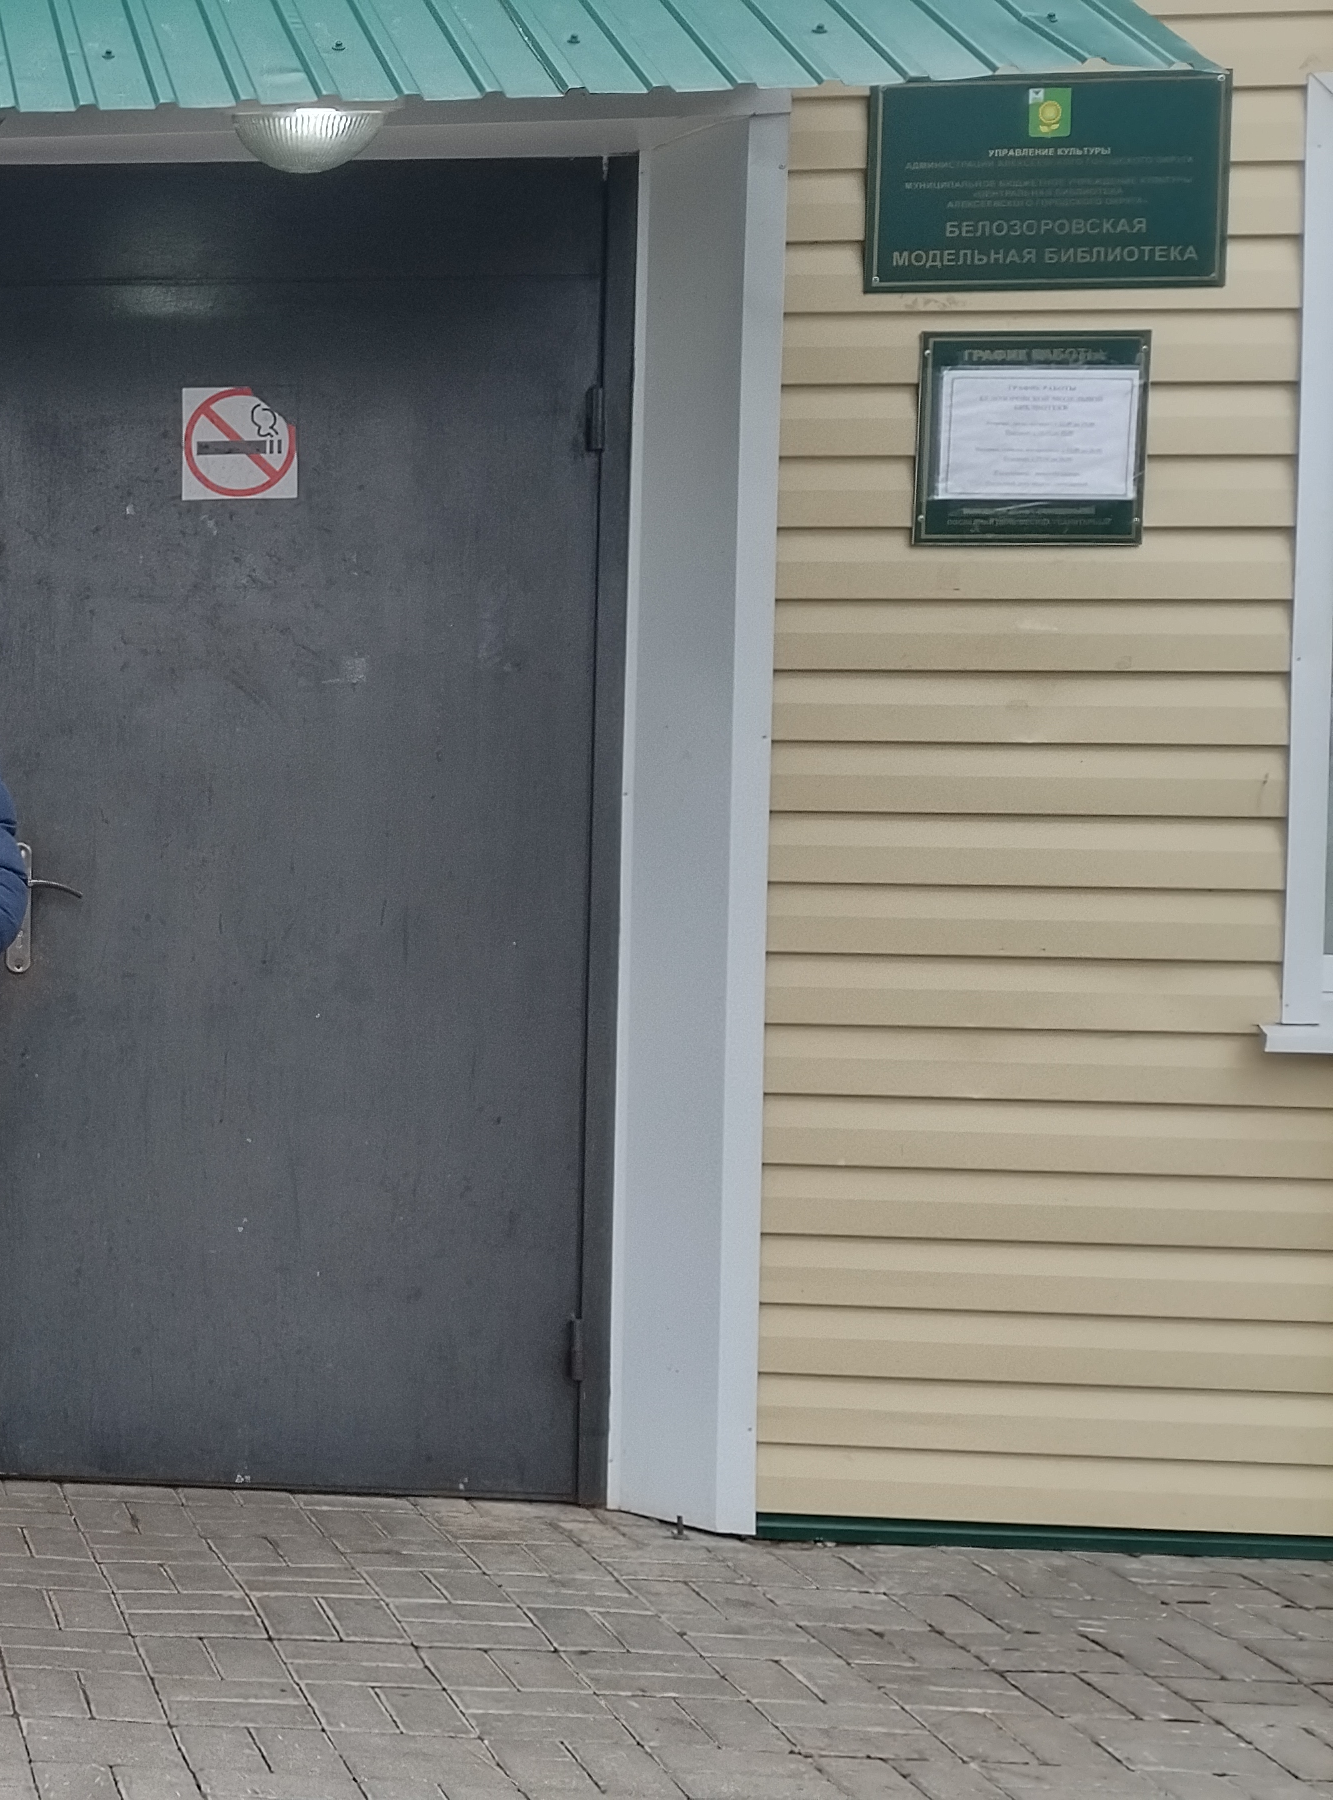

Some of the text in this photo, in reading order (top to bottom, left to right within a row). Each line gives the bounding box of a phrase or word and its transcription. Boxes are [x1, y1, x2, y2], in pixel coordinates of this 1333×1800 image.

[988, 146, 1111, 157] УПРАВЛЕНИЕ КУЛЬТУРЫ
[945, 218, 1146, 238] БЕЛОЗОРОВСКАЯ
[893, 245, 1198, 269] МОДЕЛЬНАЯ БИБЛИОТЕКА
